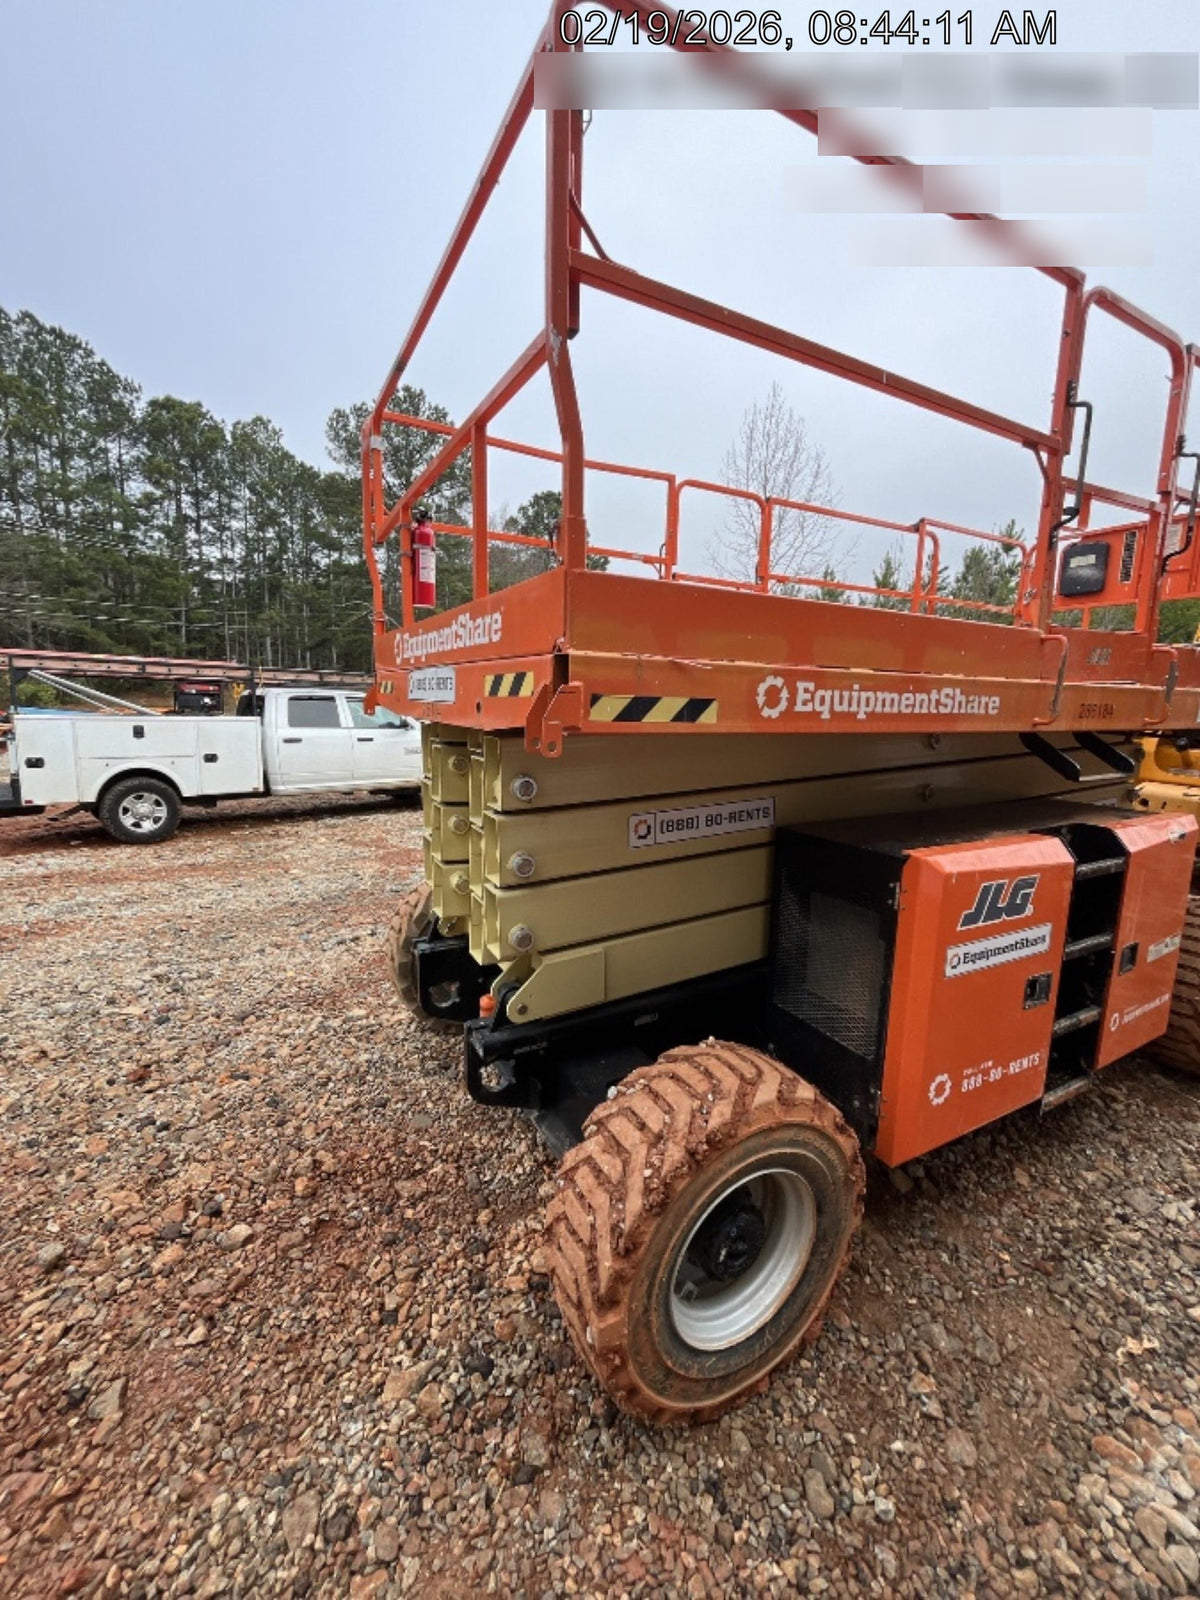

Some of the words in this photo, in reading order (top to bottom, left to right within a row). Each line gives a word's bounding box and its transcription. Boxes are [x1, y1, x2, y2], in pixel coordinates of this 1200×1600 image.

[403, 611, 502, 664] EquipmentShare
[794, 681, 1000, 719] EquipmentShare
[705, 806, 771, 828] 80-RENTS
[957, 874, 1041, 931] JLG
